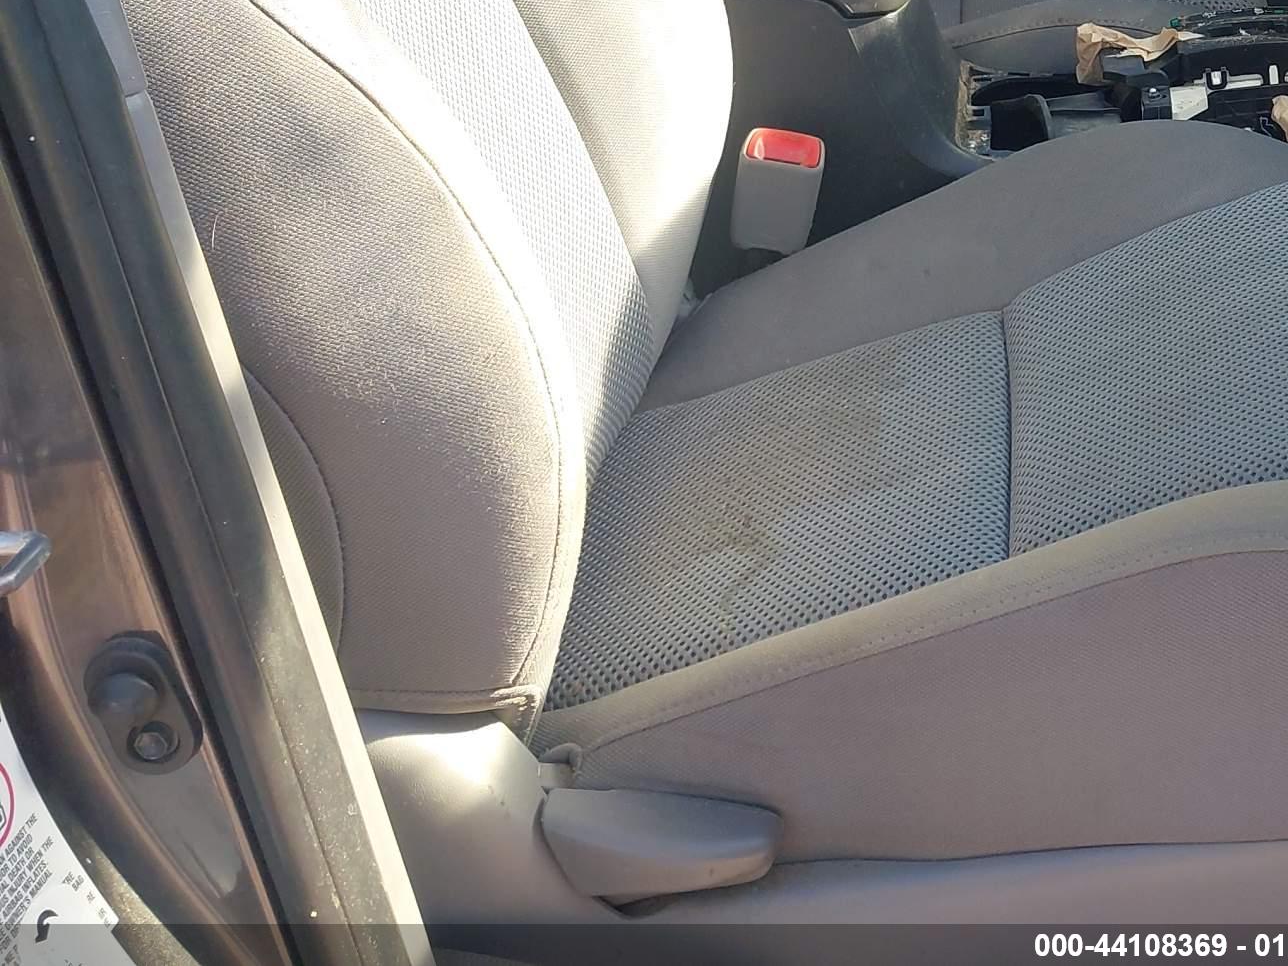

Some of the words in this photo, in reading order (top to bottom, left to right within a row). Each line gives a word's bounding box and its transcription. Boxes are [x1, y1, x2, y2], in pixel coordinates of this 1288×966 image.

[5, 825, 28, 856] AGAINST
[25, 813, 38, 831] THE
[8, 854, 18, 867] TO
[17, 833, 33, 856] AVOID
[41, 835, 55, 852] THE
[29, 869, 53, 898] MANUAL
